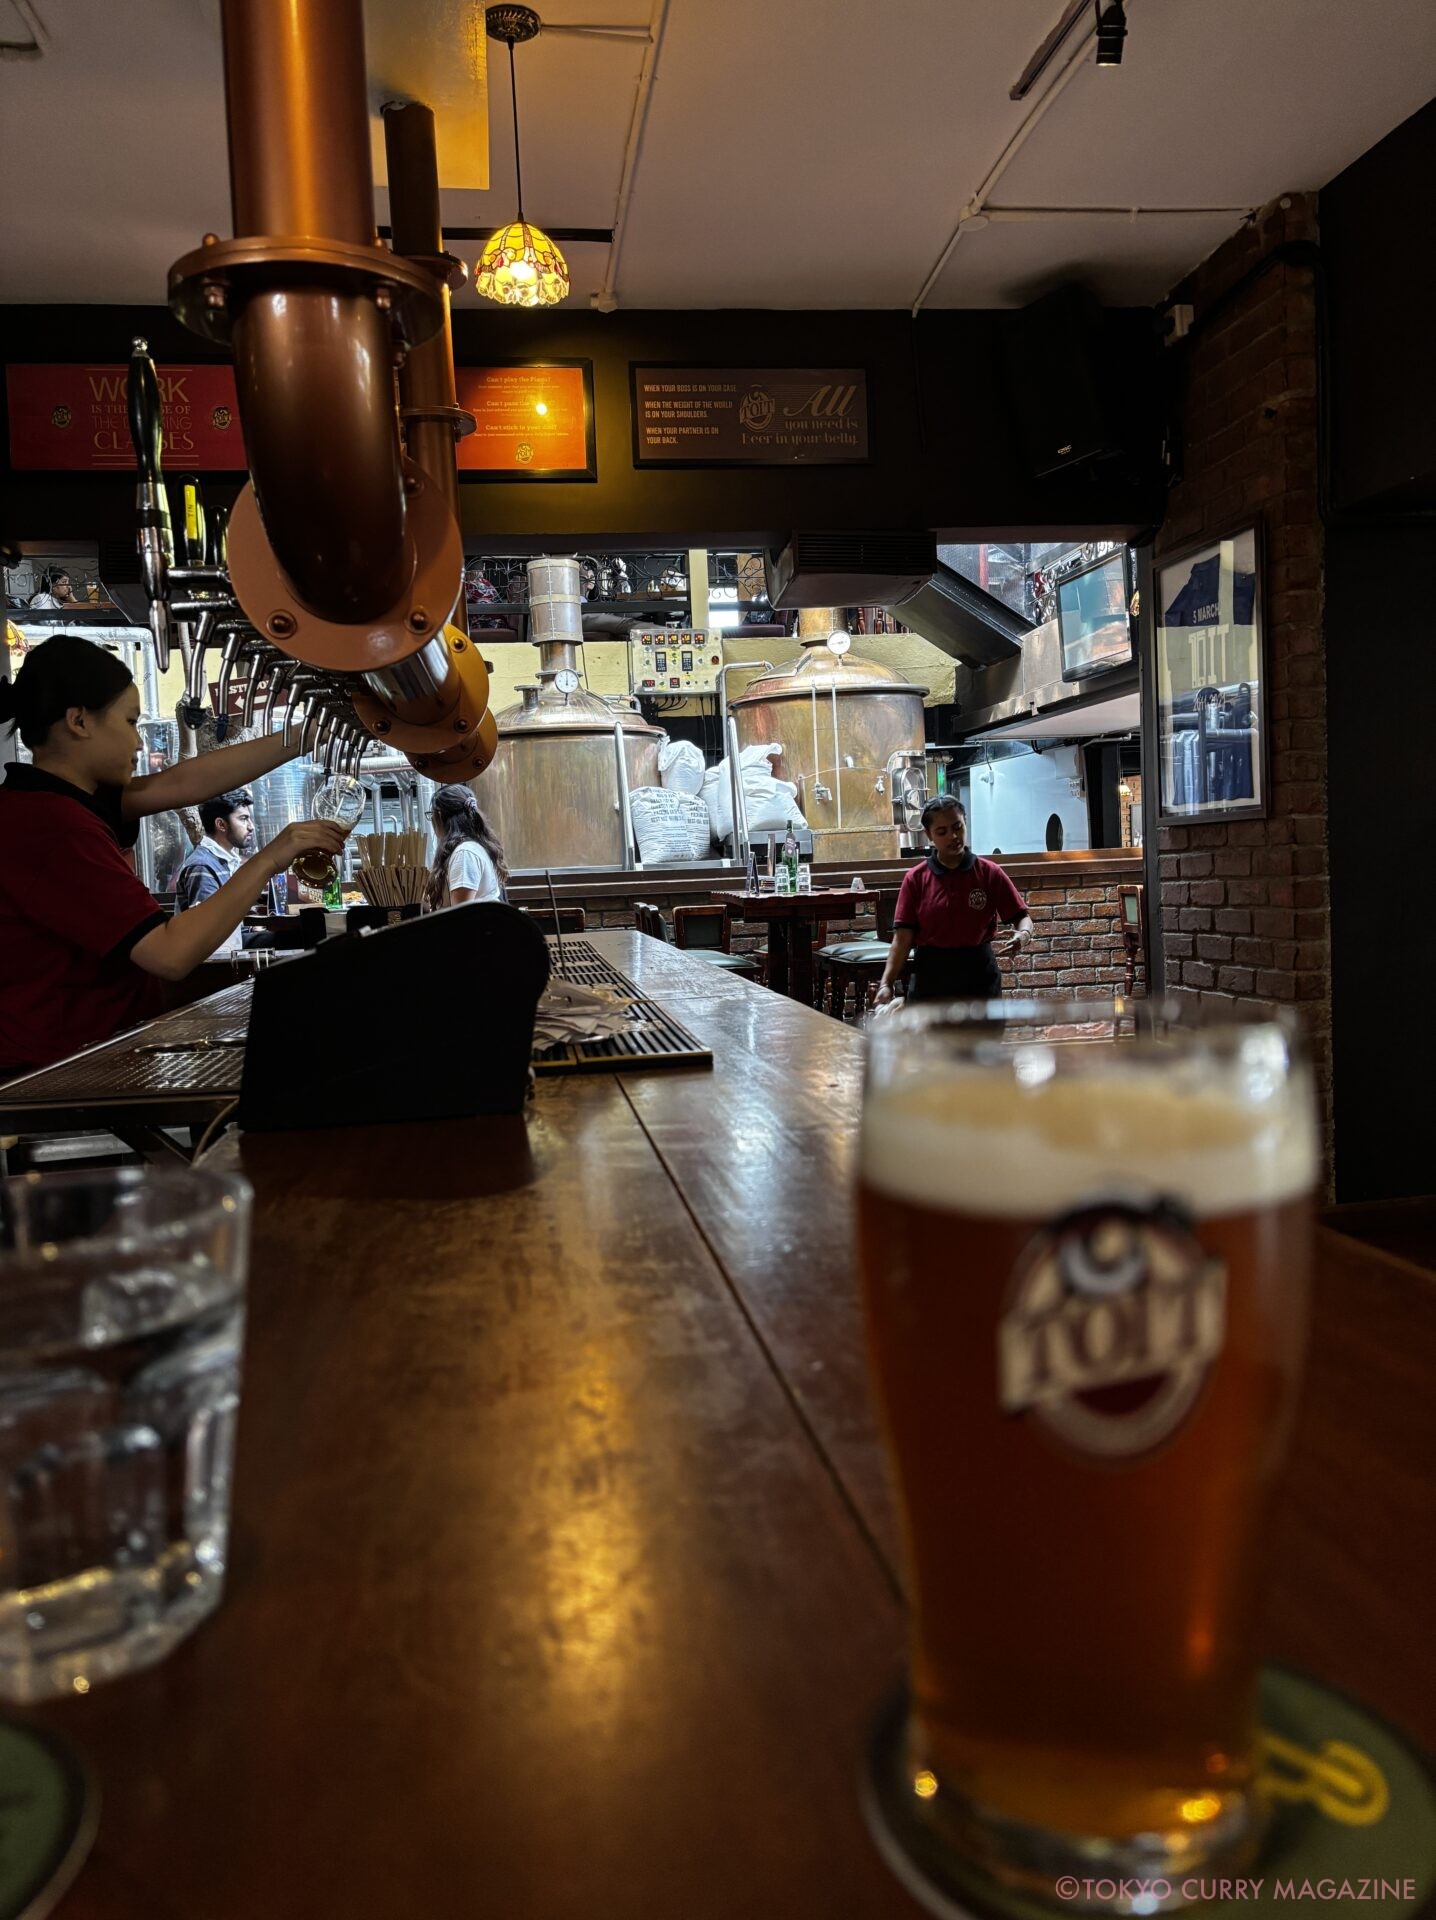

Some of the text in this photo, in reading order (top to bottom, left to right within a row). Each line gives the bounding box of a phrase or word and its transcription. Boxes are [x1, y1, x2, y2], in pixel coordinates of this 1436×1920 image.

[644, 384, 736, 392] WHEN YOUR BOSS IS ON YOUR CASE
[645, 401, 733, 409] WHEN THE WEIGHT OF THE WORLD
[783, 385, 857, 416] All
[91, 404, 101, 414] IS
[175, 405, 191, 414] OF
[645, 410, 708, 418] IS ON YOUR SHOULDERS.
[785, 417, 859, 431] you need is
[646, 427, 719, 435] WHEN YOUR PARTNER IS ON
[647, 437, 661, 445] YOUR
[775, 432, 788, 444] in
[791, 434, 822, 446] your
[1192, 602, 1221, 624] 5 MARCH
